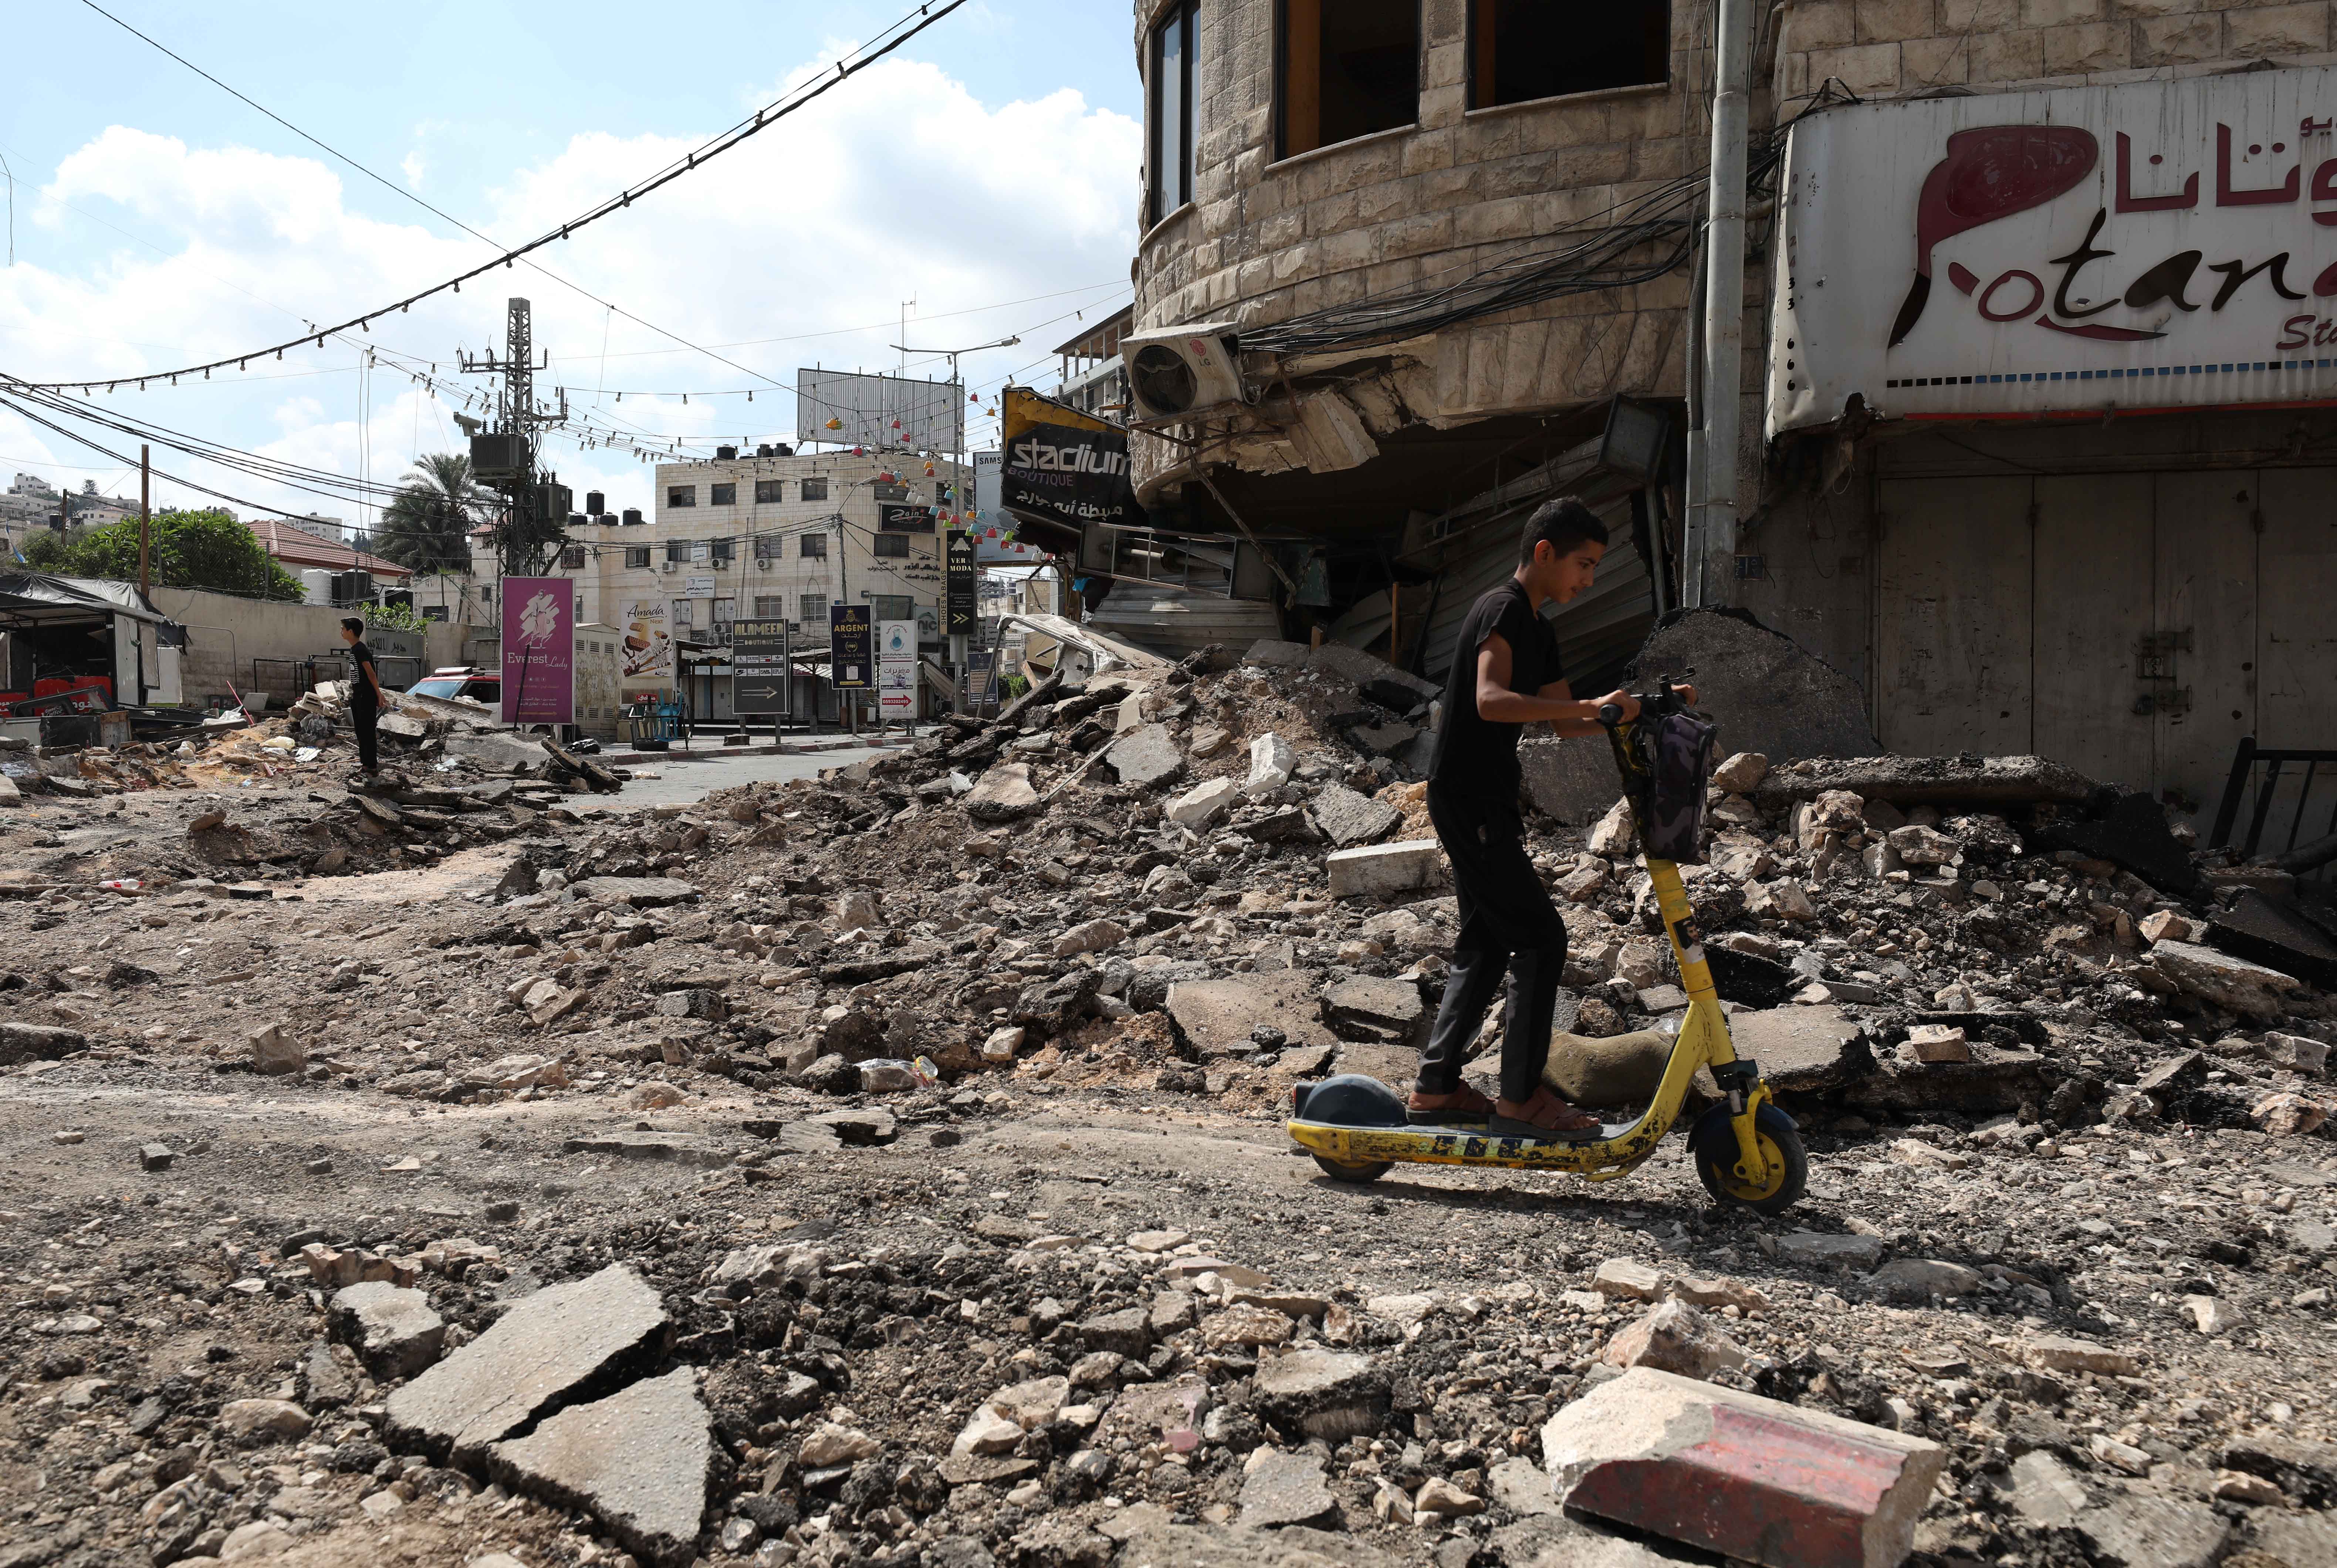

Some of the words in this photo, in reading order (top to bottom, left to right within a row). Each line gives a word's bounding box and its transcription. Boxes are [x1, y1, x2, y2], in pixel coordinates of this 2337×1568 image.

[979, 457, 1002, 465] SAMS
[1007, 467, 1073, 487] BOUTIQUE
[626, 604, 665, 618] Amada
[735, 623, 784, 635] ALAMEER
[507, 652, 548, 663] Everest
[545, 656, 568, 670] Lady
